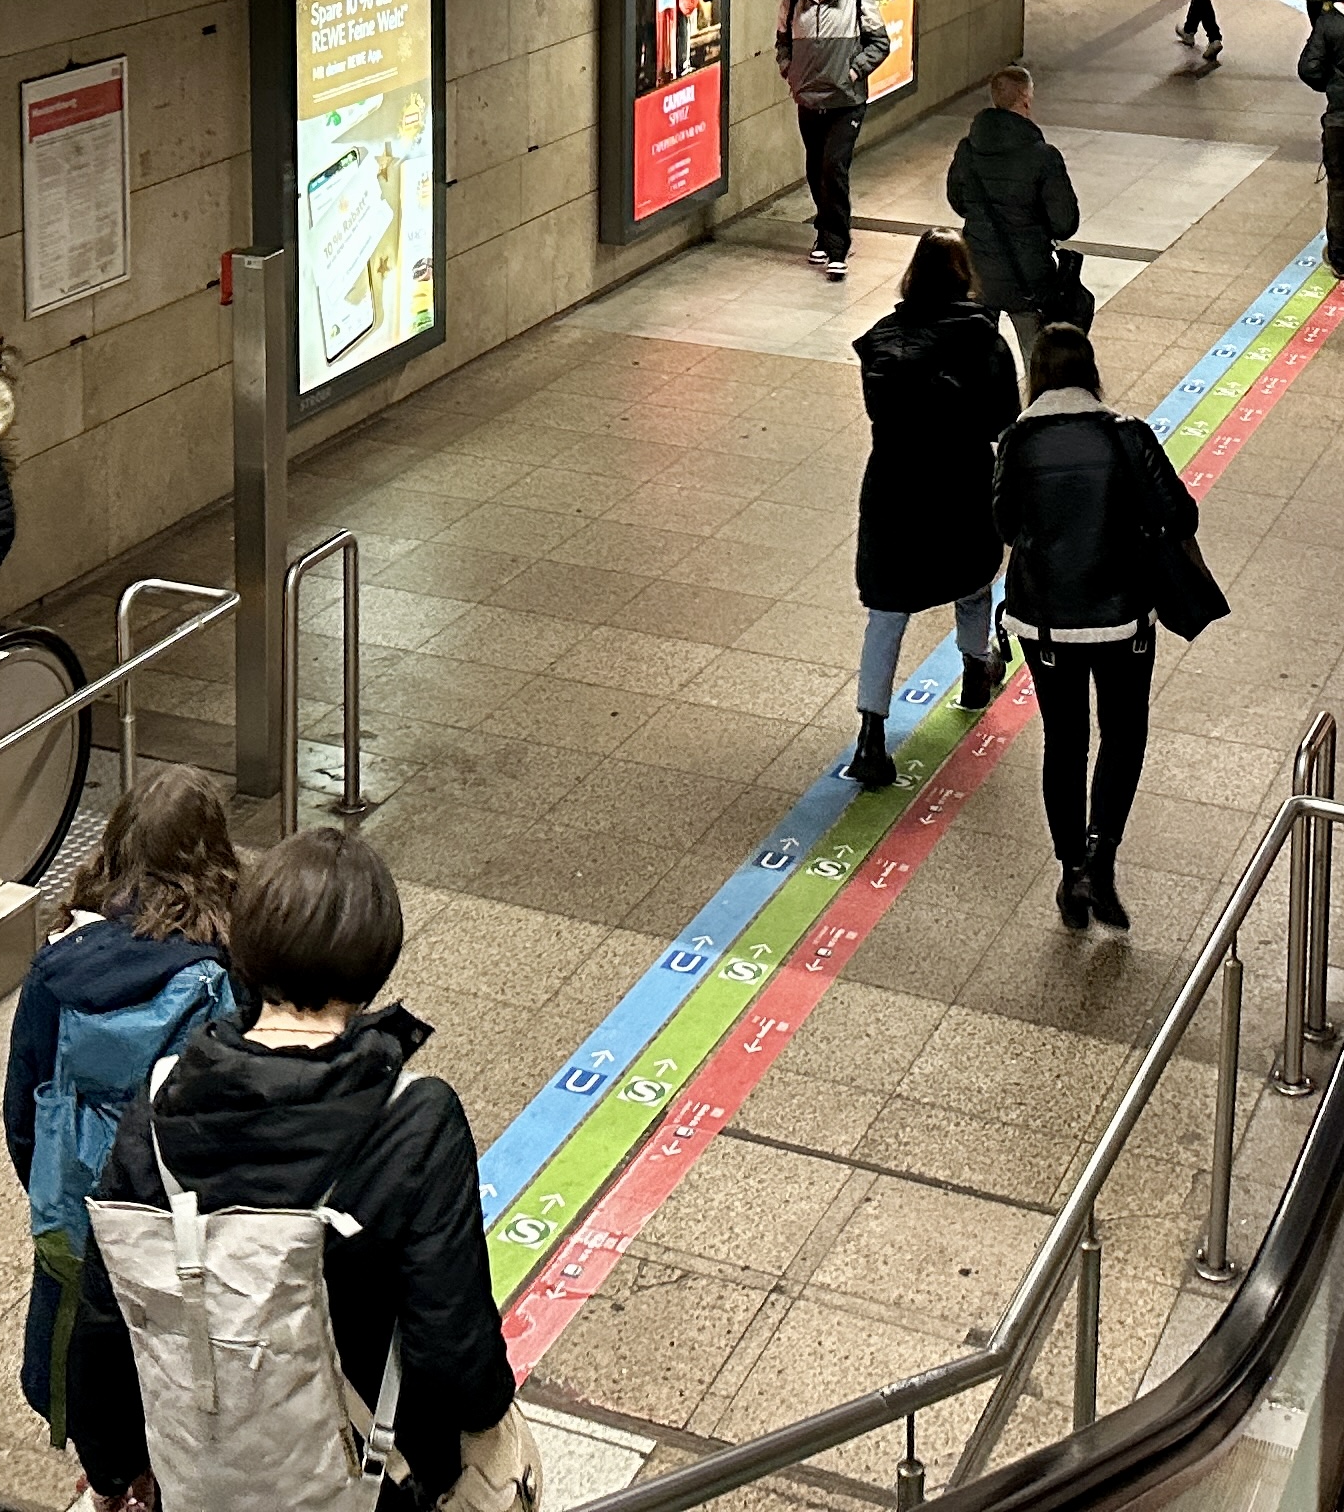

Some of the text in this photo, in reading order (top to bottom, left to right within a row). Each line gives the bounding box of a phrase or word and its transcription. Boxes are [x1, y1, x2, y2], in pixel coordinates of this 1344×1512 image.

[311, 2, 343, 29] Spare
[311, 22, 347, 54] REWE
[348, 17, 376, 42] Feine
[905, 690, 931, 703] U
[760, 853, 789, 869] U
[813, 859, 845, 877] S
[670, 951, 702, 973] U
[724, 961, 760, 981] S
[565, 1069, 600, 1093] U
[625, 1079, 663, 1103] S
[506, 1217, 547, 1245] S
